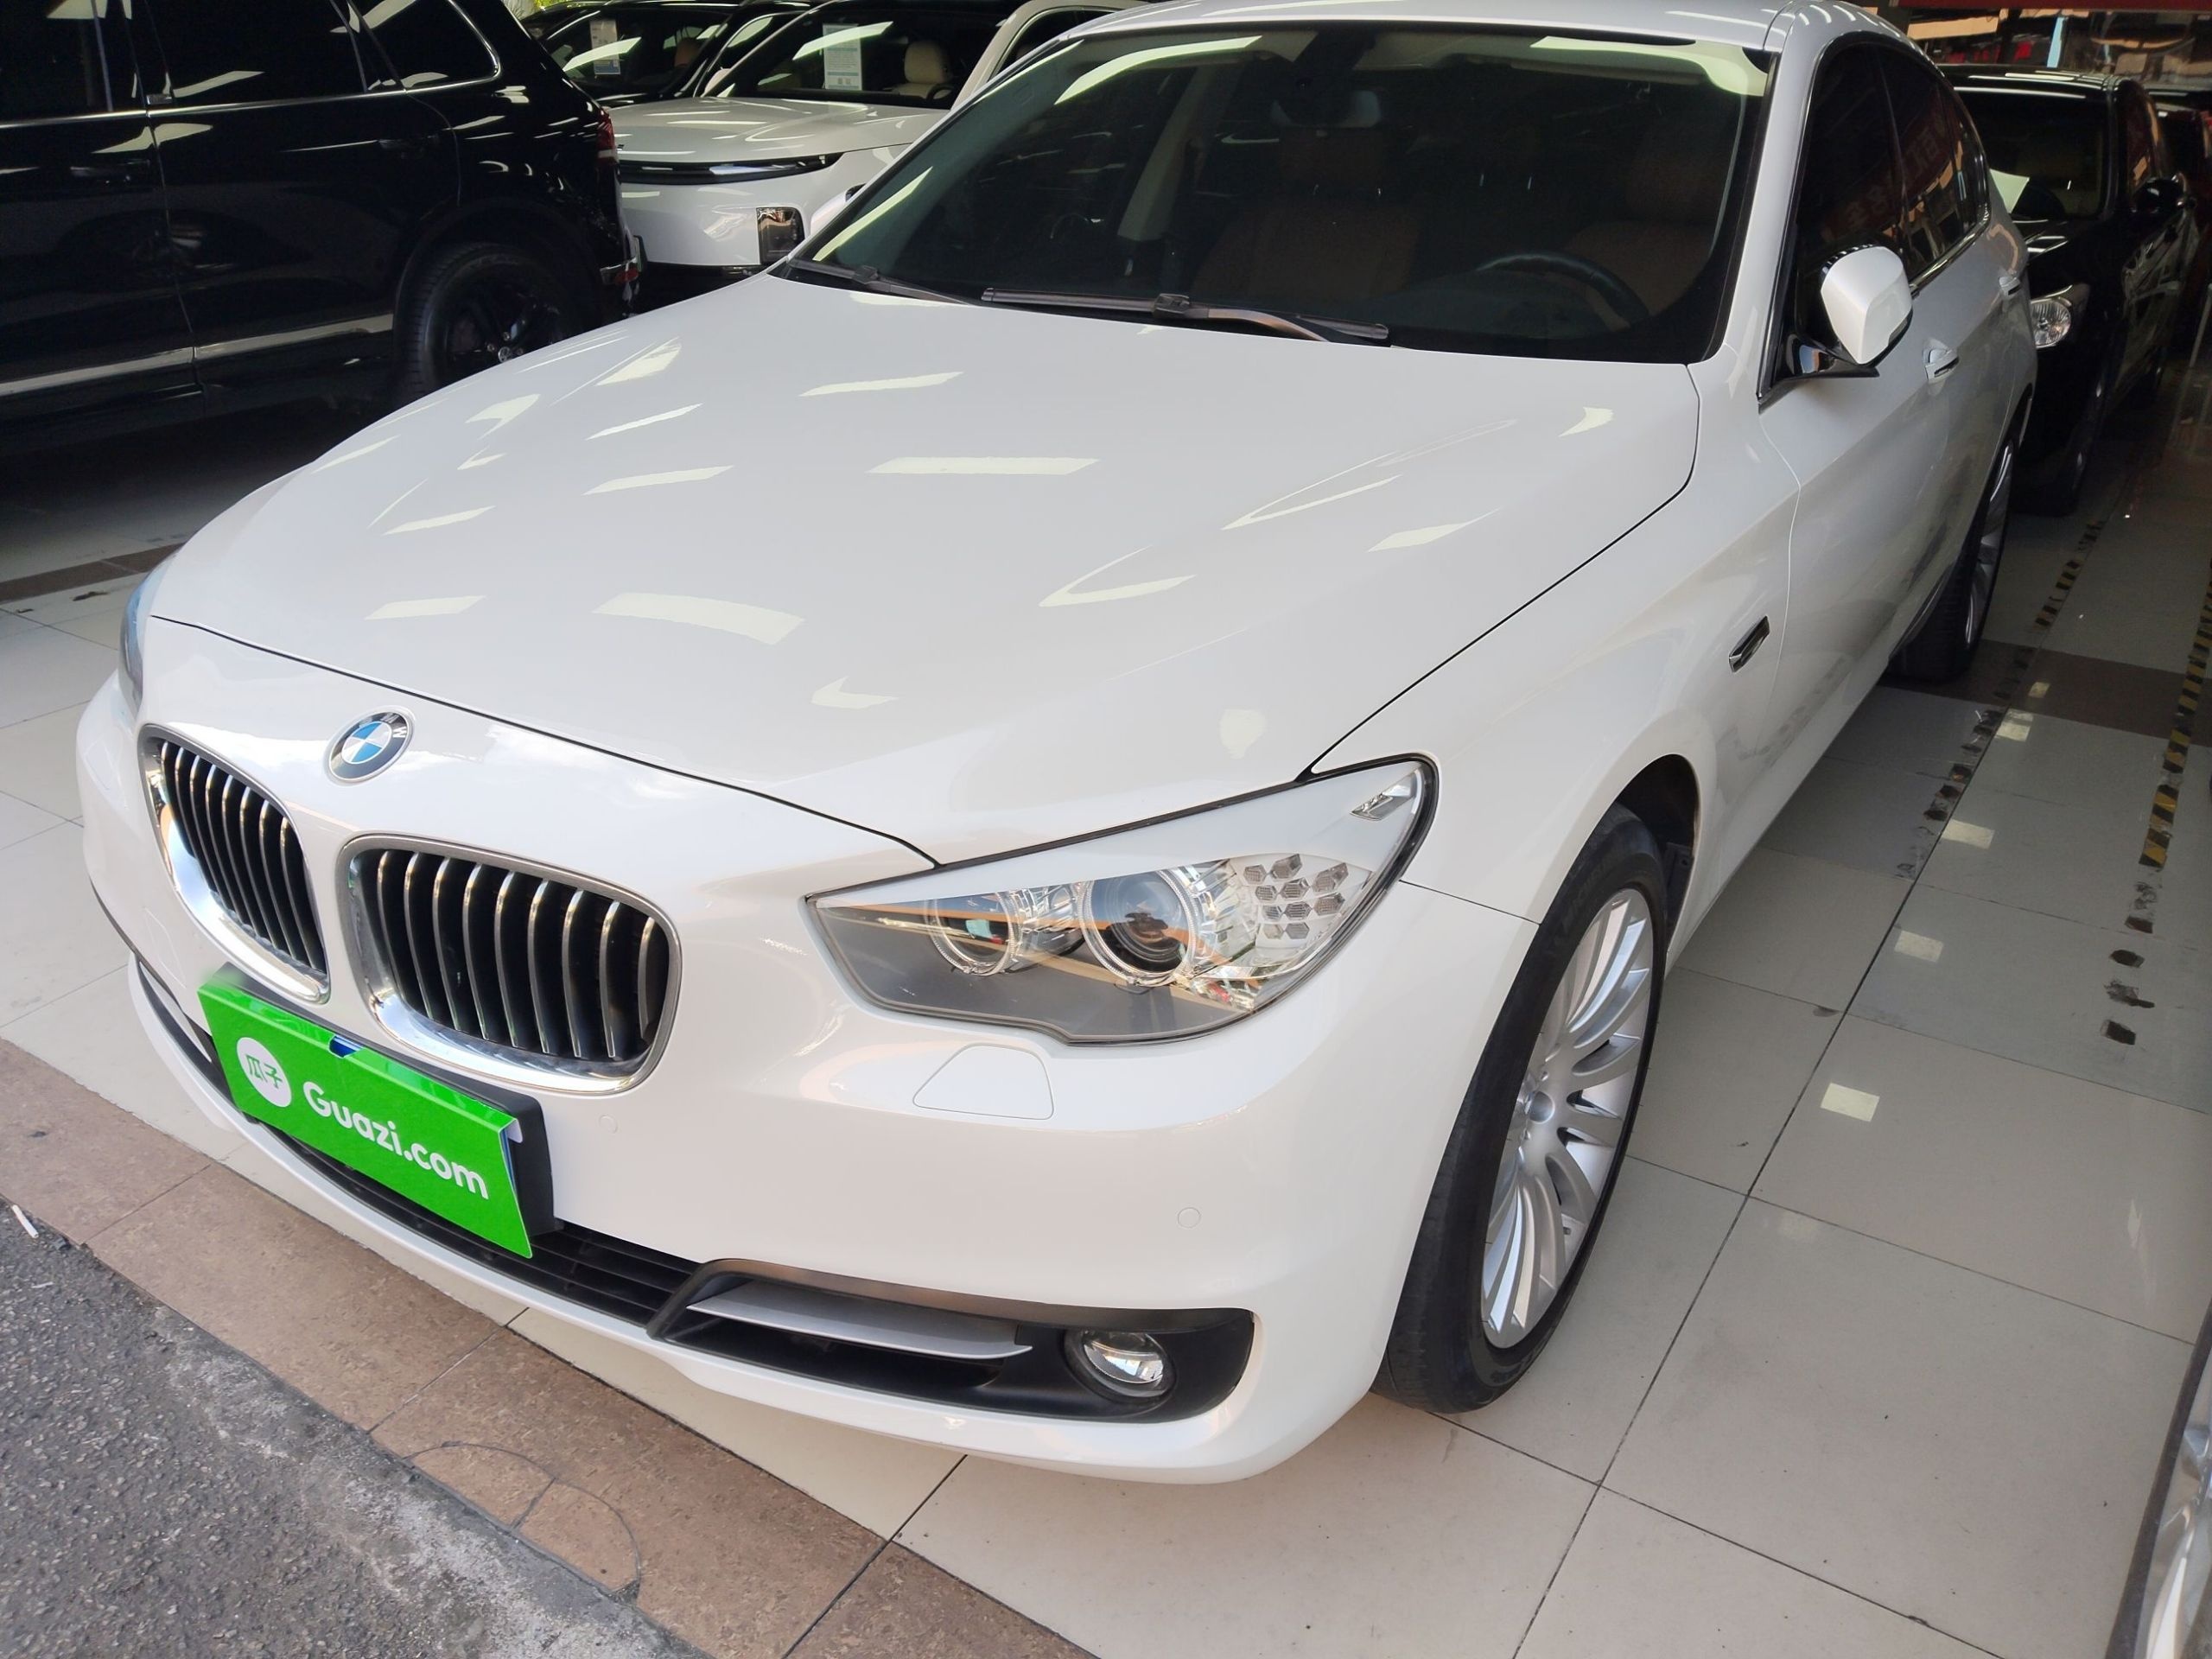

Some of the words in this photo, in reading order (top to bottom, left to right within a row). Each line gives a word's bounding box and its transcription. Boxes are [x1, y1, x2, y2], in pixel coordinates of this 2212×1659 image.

[358, 712, 407, 738] MW
[245, 1053, 283, 1089] 瓜子
[302, 1081, 489, 1199] Guazi.com
